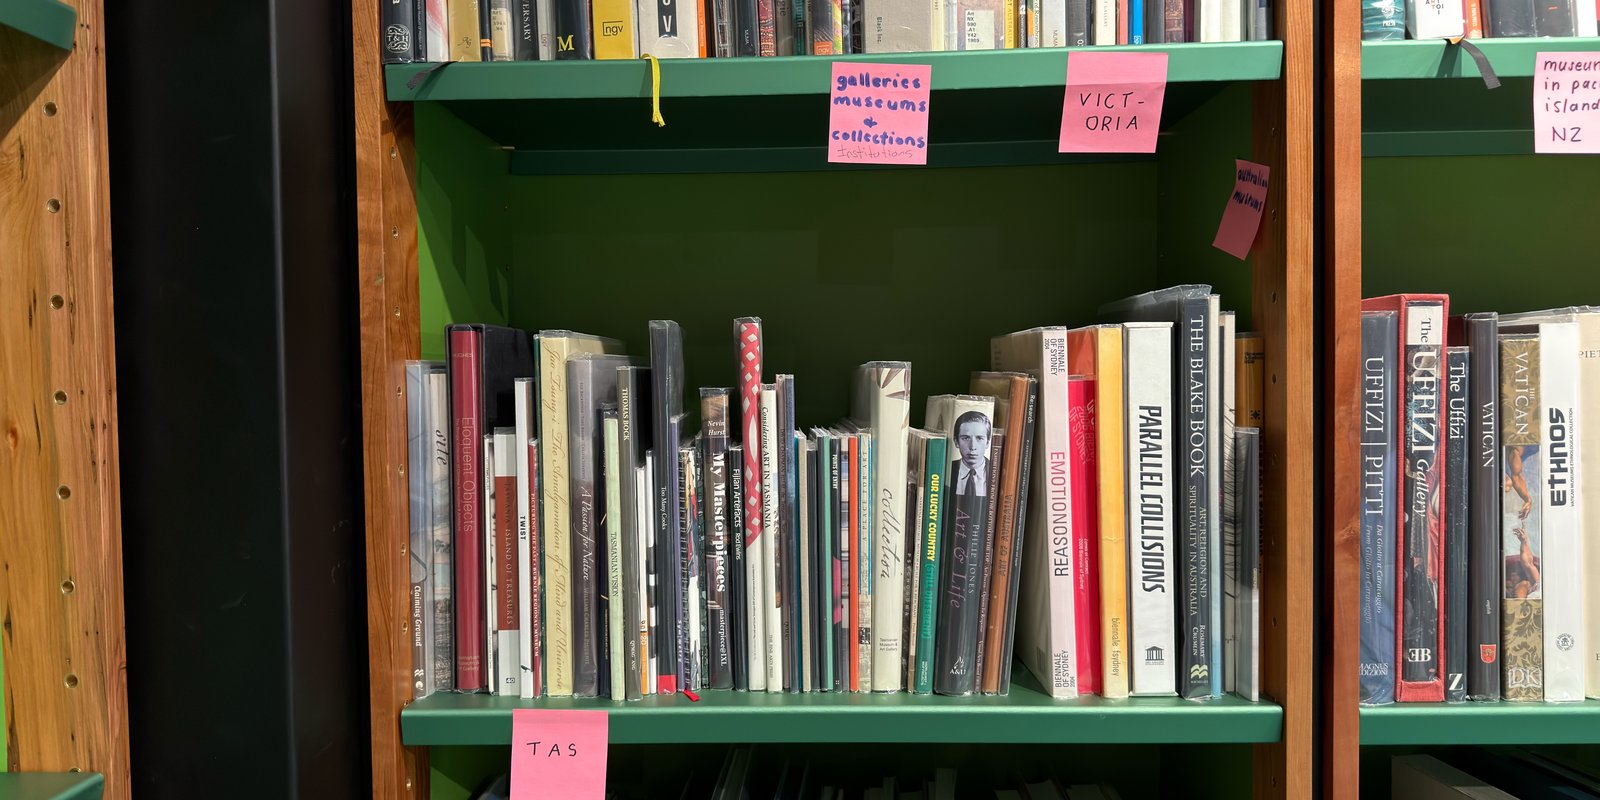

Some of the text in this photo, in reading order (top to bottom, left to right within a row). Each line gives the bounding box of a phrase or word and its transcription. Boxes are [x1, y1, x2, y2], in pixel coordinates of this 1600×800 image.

[557, 34, 575, 52] M
[605, 24, 624, 36] ngv
[836, 71, 921, 91] galleries
[1544, 77, 1600, 94] in pac
[833, 94, 927, 113] museums
[831, 128, 926, 149] collections
[1085, 115, 1138, 132] ORIA
[1552, 126, 1582, 142] NZ
[1050, 338, 1057, 347] OF
[1057, 338, 1065, 373] BIENNALE
[1027, 394, 1036, 423] Re:search
[1190, 315, 1205, 478] THE BLAKE BOOK
[1449, 362, 1465, 439] The Uffizi
[1515, 352, 1528, 434] VATICAN
[761, 407, 769, 449] Considering
[1411, 318, 1437, 517] The UFFIZI Gallery
[436, 430, 449, 466] site
[551, 429, 566, 456] The
[1365, 356, 1384, 516] UFFIZI PITTI
[1482, 401, 1494, 468] VATICAN
[1548, 408, 1568, 506] ETHNOS
[461, 417, 476, 532] Eloquent Objects
[732, 468, 741, 490] Fijian
[764, 471, 770, 479] IN
[931, 474, 939, 492] OUR
[545, 459, 568, 550] Amalgamation
[582, 486, 592, 497] A
[929, 494, 938, 521] LUCKY
[1139, 405, 1165, 593] PARALLEL COLLISIONS
[581, 500, 593, 532] Passion
[710, 452, 727, 592] My Masterpieces
[733, 491, 742, 527] Artefacts
[1198, 507, 1206, 527] ART,
[573, 522, 595, 549] for
[880, 488, 901, 579] collection
[927, 522, 937, 561] COUNTRY
[1377, 524, 1383, 536] Da
[582, 550, 594, 581] Nature
[947, 508, 970, 609] Art & Life
[968, 525, 980, 594] PHILIP JONES
[1189, 485, 1198, 616] SPIRITUALITY IN AUSTRALIA
[1199, 529, 1207, 575] RELIGION
[414, 585, 422, 617] Claiming
[554, 569, 567, 608] Mind
[611, 575, 619, 597] VISION
[1375, 570, 1383, 613] Caravaggio
[1364, 581, 1372, 624] Caravaggio
[555, 609, 566, 636] and
[1112, 617, 1121, 646] biennale
[555, 637, 567, 689] Universe
[1054, 653, 1062, 687] BIENNALE
[1061, 650, 1069, 687] OF SYDNEY
[1508, 669, 1541, 687] DK
[1449, 673, 1463, 690] Z
[526, 742, 577, 757] TAS
